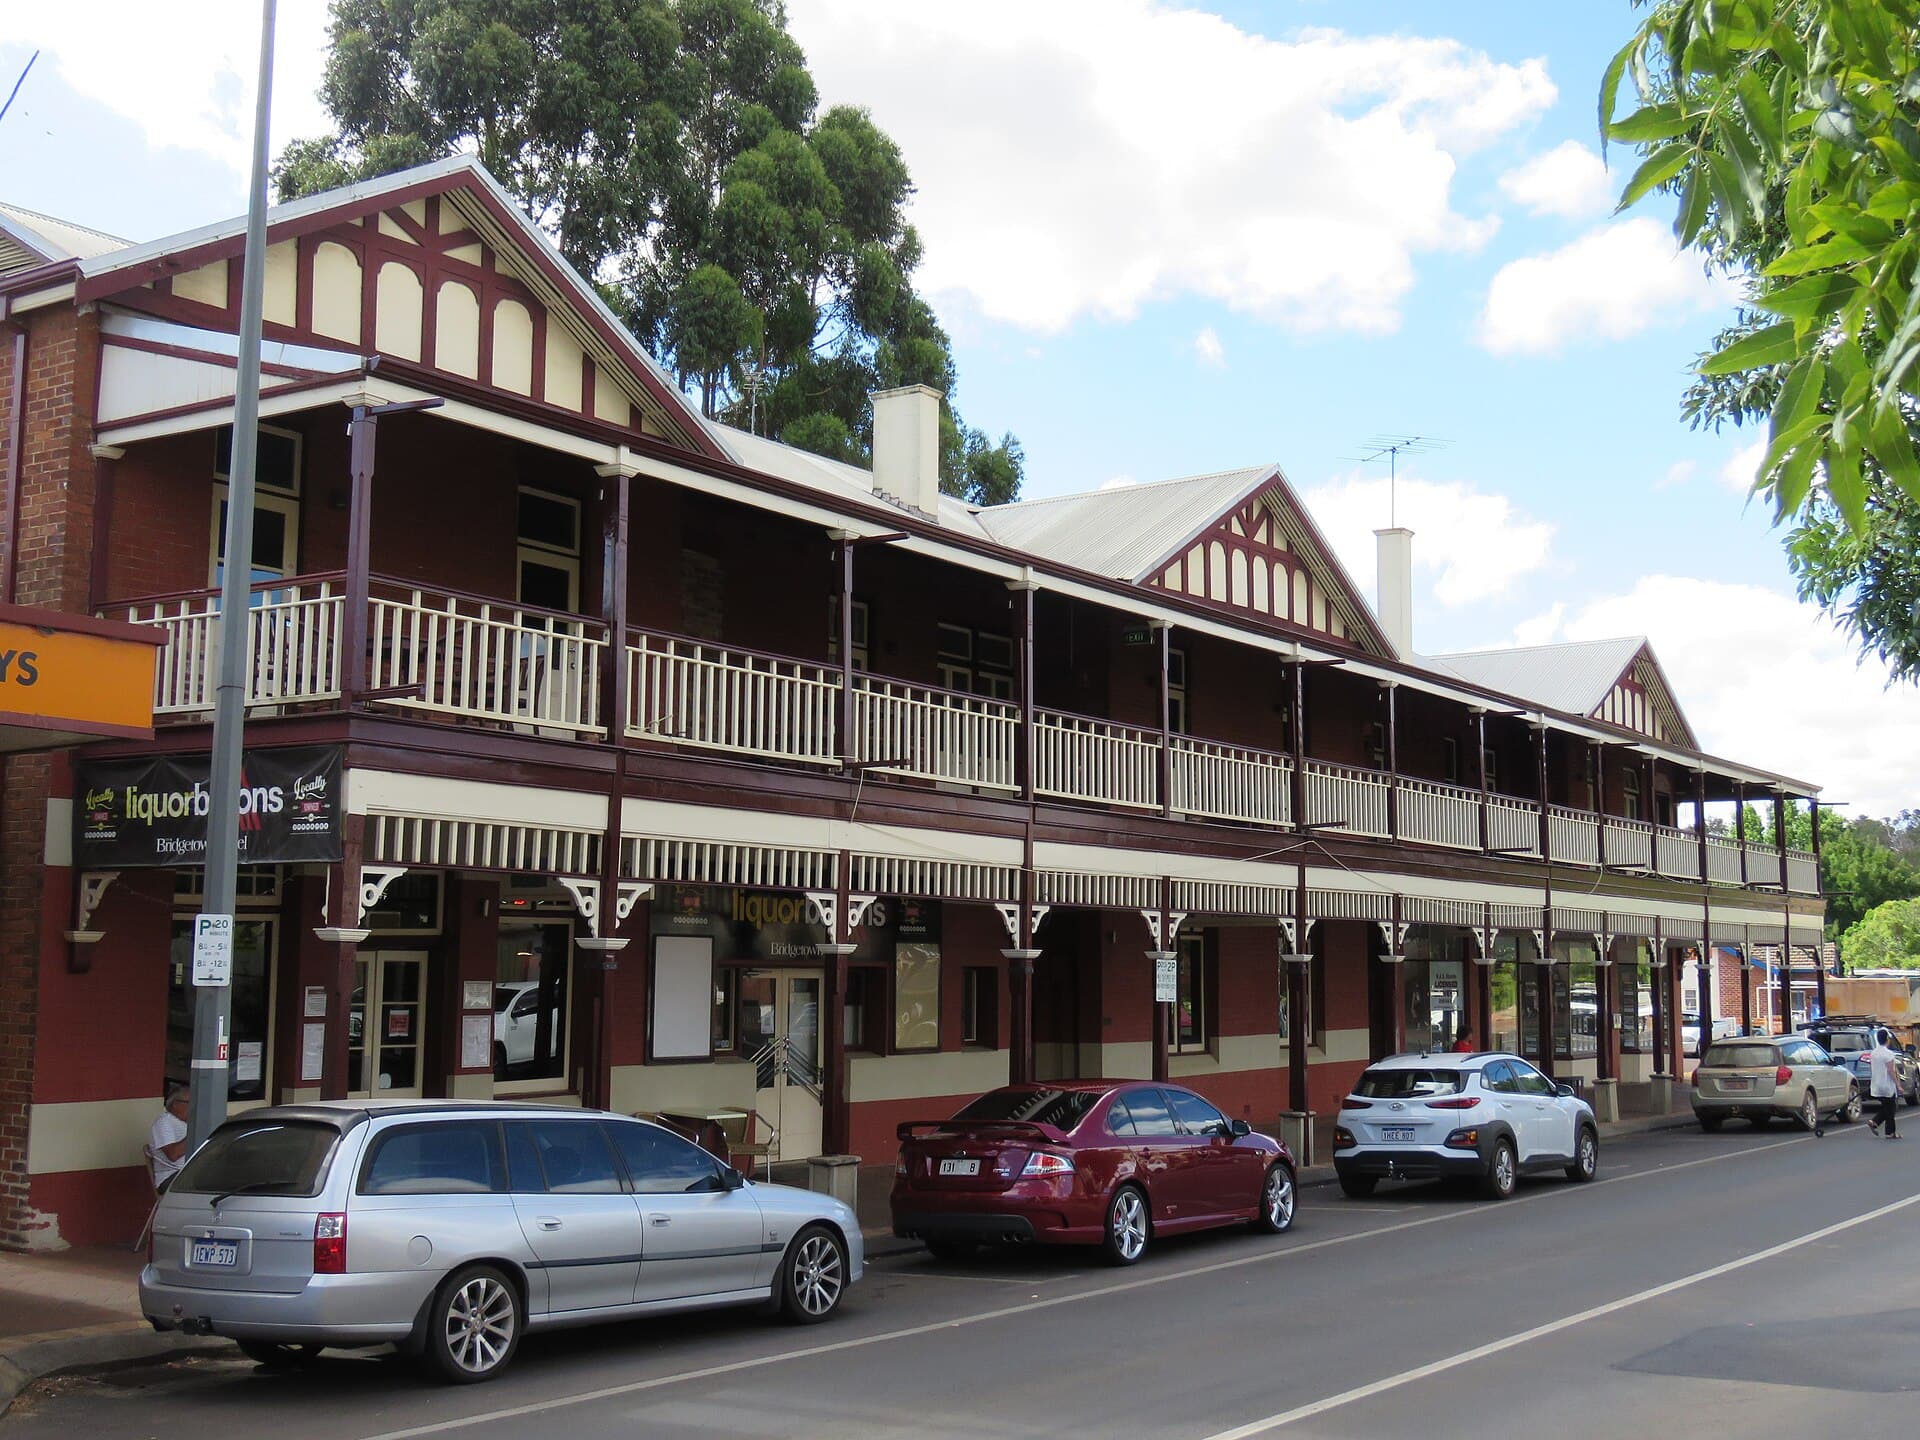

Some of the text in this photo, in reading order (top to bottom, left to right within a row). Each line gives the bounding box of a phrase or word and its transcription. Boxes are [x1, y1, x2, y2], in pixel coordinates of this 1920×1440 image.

[0, 649, 38, 686] YS
[293, 775, 326, 800] Locally
[126, 782, 284, 826] liquorbons
[200, 920, 211, 935] P
